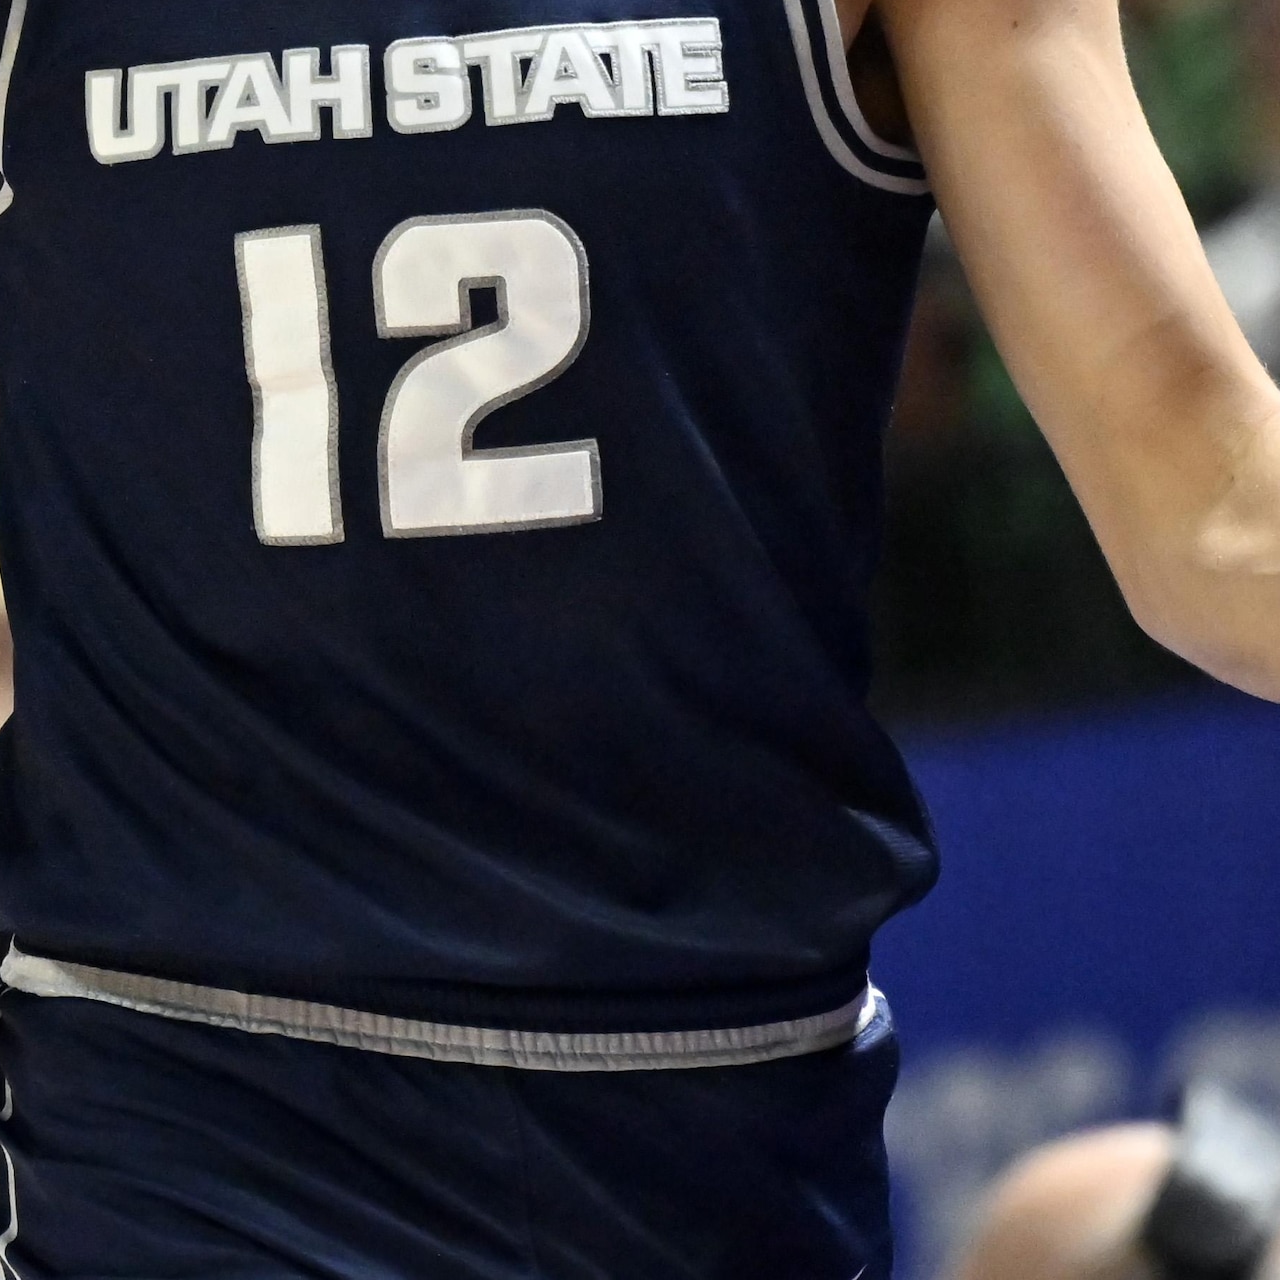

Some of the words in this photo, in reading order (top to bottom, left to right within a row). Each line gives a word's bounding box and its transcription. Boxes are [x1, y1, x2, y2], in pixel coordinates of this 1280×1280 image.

[85, 43, 373, 164] UTAH
[385, 18, 729, 135] STATE
[234, 208, 603, 545] 12
